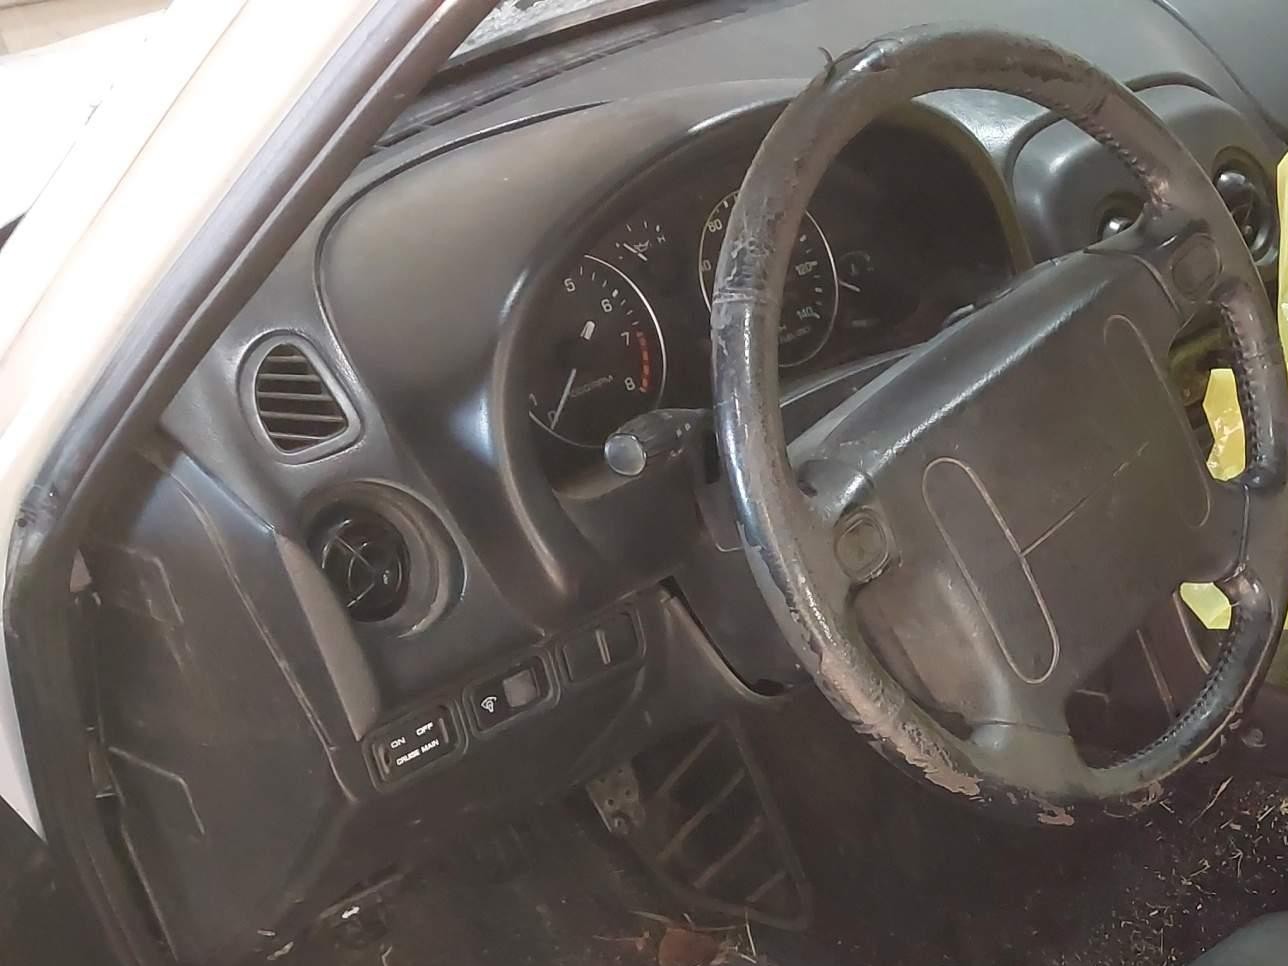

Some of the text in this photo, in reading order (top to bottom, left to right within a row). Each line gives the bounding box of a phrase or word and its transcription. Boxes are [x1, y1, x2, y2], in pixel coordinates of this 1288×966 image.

[708, 218, 723, 233] 80
[563, 278, 576, 293] 5
[600, 298, 613, 313] 6
[620, 331, 631, 346] 7
[624, 376, 636, 391] 8
[390, 722, 434, 749] ON OFF
[396, 738, 440, 766] CRUISE MAIN
